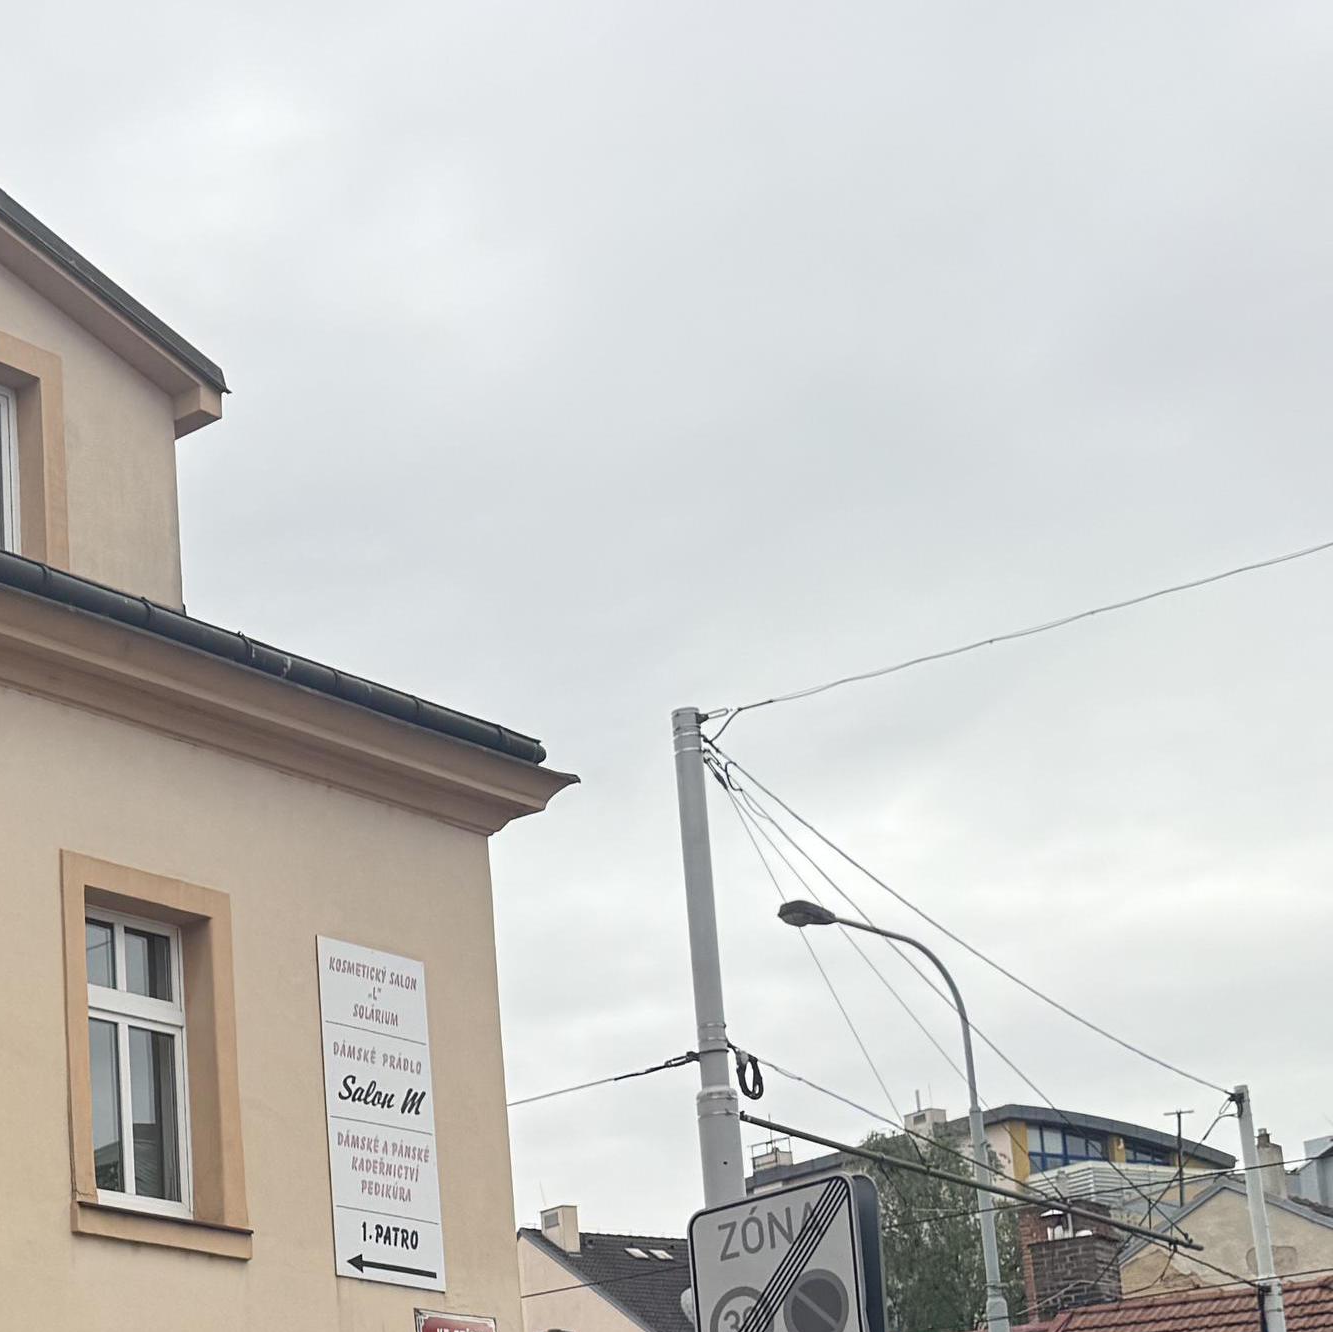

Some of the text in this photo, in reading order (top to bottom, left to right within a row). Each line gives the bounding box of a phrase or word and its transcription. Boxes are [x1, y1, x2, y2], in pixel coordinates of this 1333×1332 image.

[329, 956, 417, 991] KOSMETICKÝ SALON
[353, 1003, 399, 1027] SOLÁRIUM
[333, 1040, 422, 1076] DÁMSKÉ PRÁDLO
[338, 1074, 426, 1116] Salon M
[337, 1130, 430, 1164] DÁMSKÉ A PÁNSKÉ
[351, 1156, 420, 1182] KADEŘNICTVÍ
[361, 1180, 412, 1202] PEDIKÚRA
